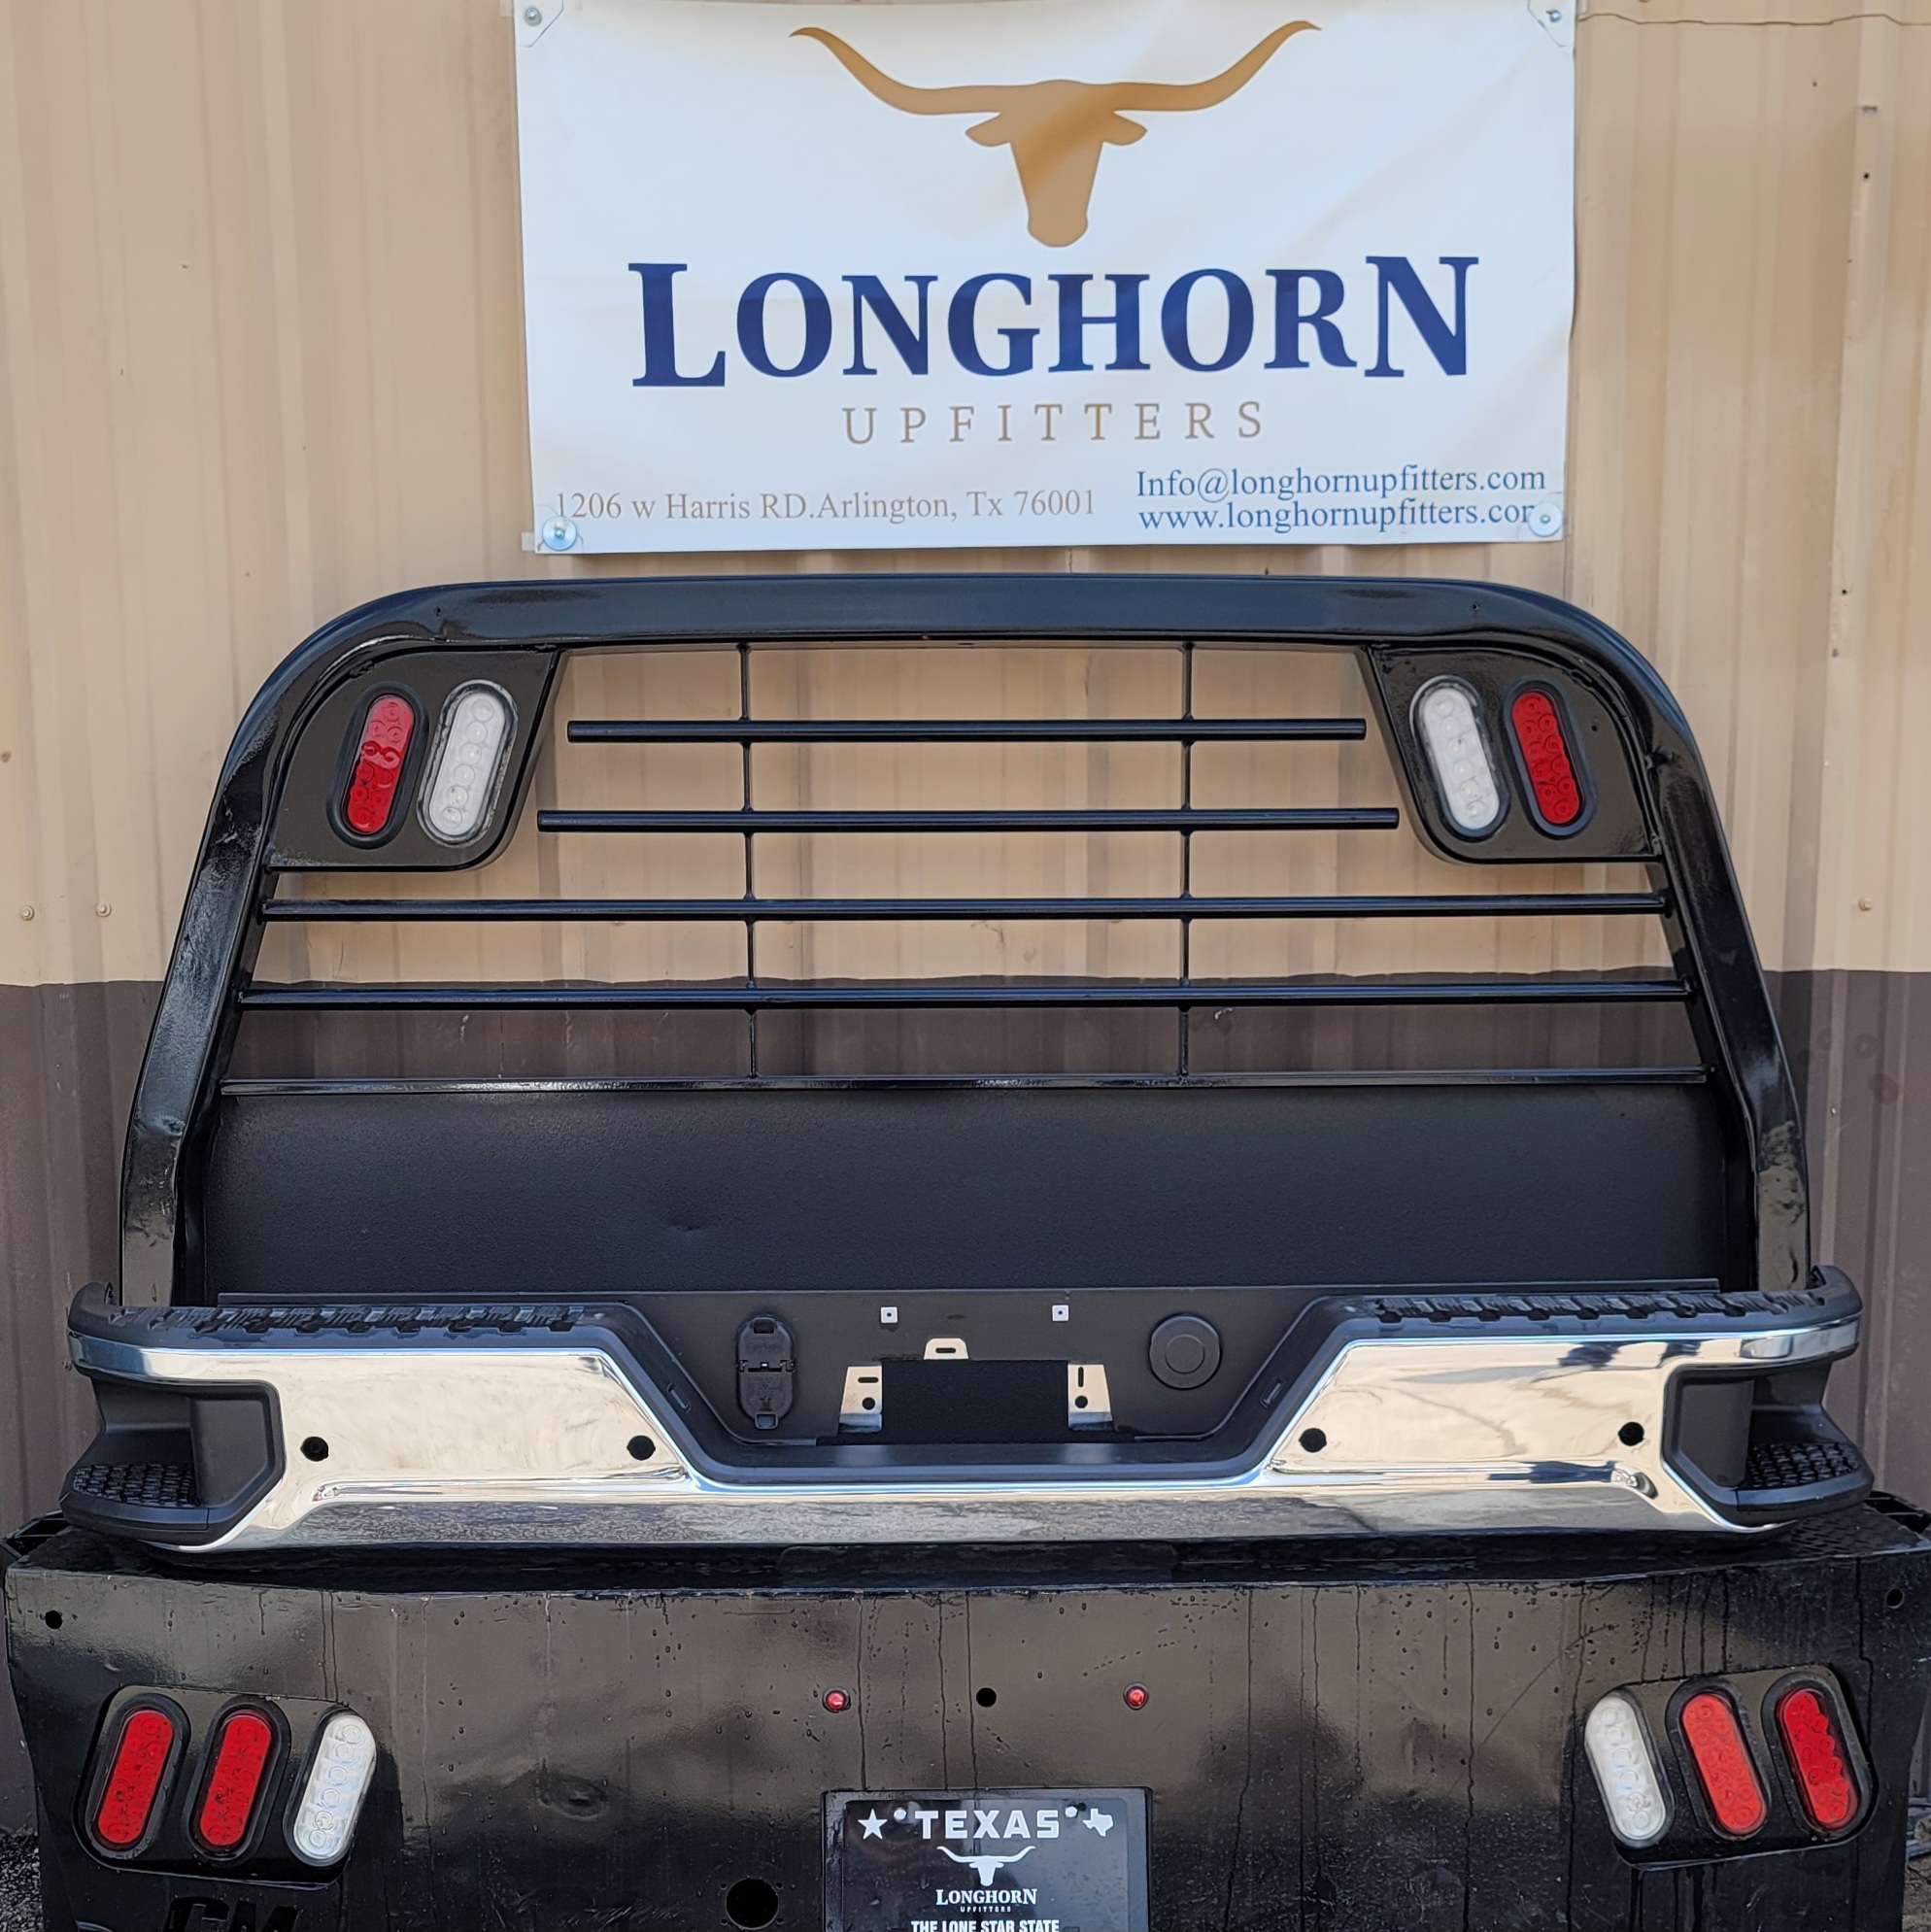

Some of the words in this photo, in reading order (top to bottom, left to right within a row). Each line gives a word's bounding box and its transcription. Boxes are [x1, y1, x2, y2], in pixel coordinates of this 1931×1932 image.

[627, 255, 1478, 387] LONGHORN
[842, 400, 1262, 445] UPFITTERS
[1135, 464, 1546, 504] Info@longhornupfitters.com
[557, 491, 622, 520] 1206
[631, 499, 656, 519] w
[665, 491, 751, 520] Harris
[966, 491, 1003, 517] Tx
[1013, 489, 1095, 517] 76001
[914, 1810, 1060, 1840] TEXAS
[935, 1888, 1038, 1906] LONGHORN
[911, 1920, 937, 1932] THE
[942, 1920, 976, 1932] LONE
[980, 1919, 1015, 1932] STAR
[1019, 1919, 1060, 1932] STATE
